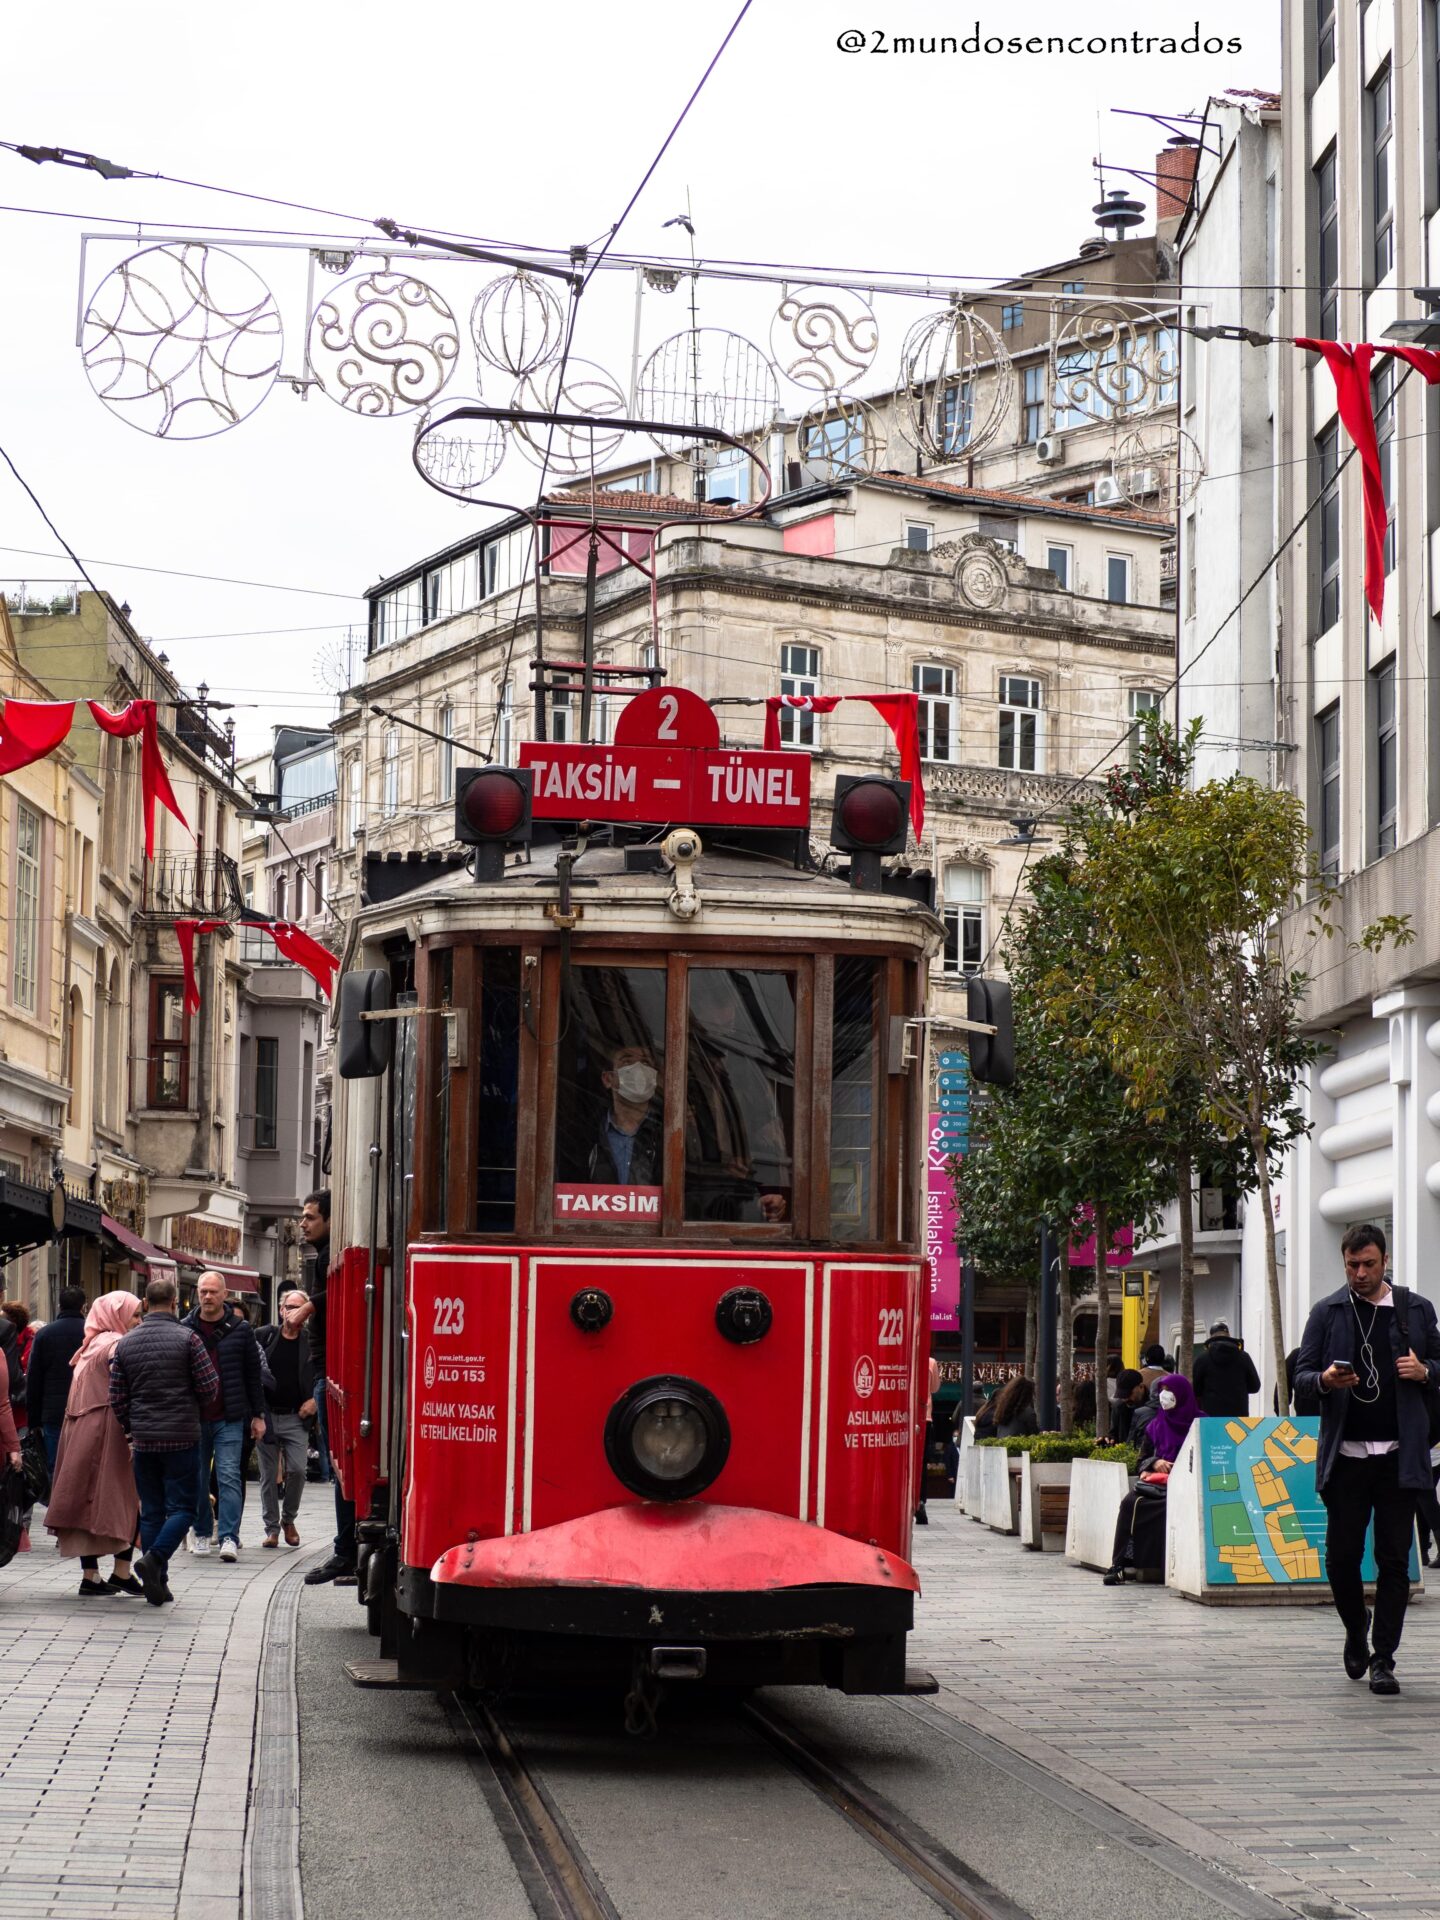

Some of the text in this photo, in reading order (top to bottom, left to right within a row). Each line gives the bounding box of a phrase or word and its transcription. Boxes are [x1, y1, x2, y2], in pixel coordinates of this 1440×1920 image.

[657, 694, 679, 740] 2
[530, 754, 637, 802] TAKSİM
[707, 756, 801, 806] TÜNEL
[556, 1191, 659, 1213] TAKSİM
[433, 1297, 465, 1335] 223
[878, 1308, 904, 1345] 223
[438, 1354, 486, 1363] www.iett.gov.tr
[437, 1369, 486, 1382] ALO 153
[878, 1378, 896, 1391] ALO
[422, 1401, 496, 1420] ASILMAK YASAK
[847, 1410, 891, 1425] ASILMAK
[420, 1422, 497, 1443] VE TEHLİKELİDİR
[844, 1433, 859, 1448] VE
